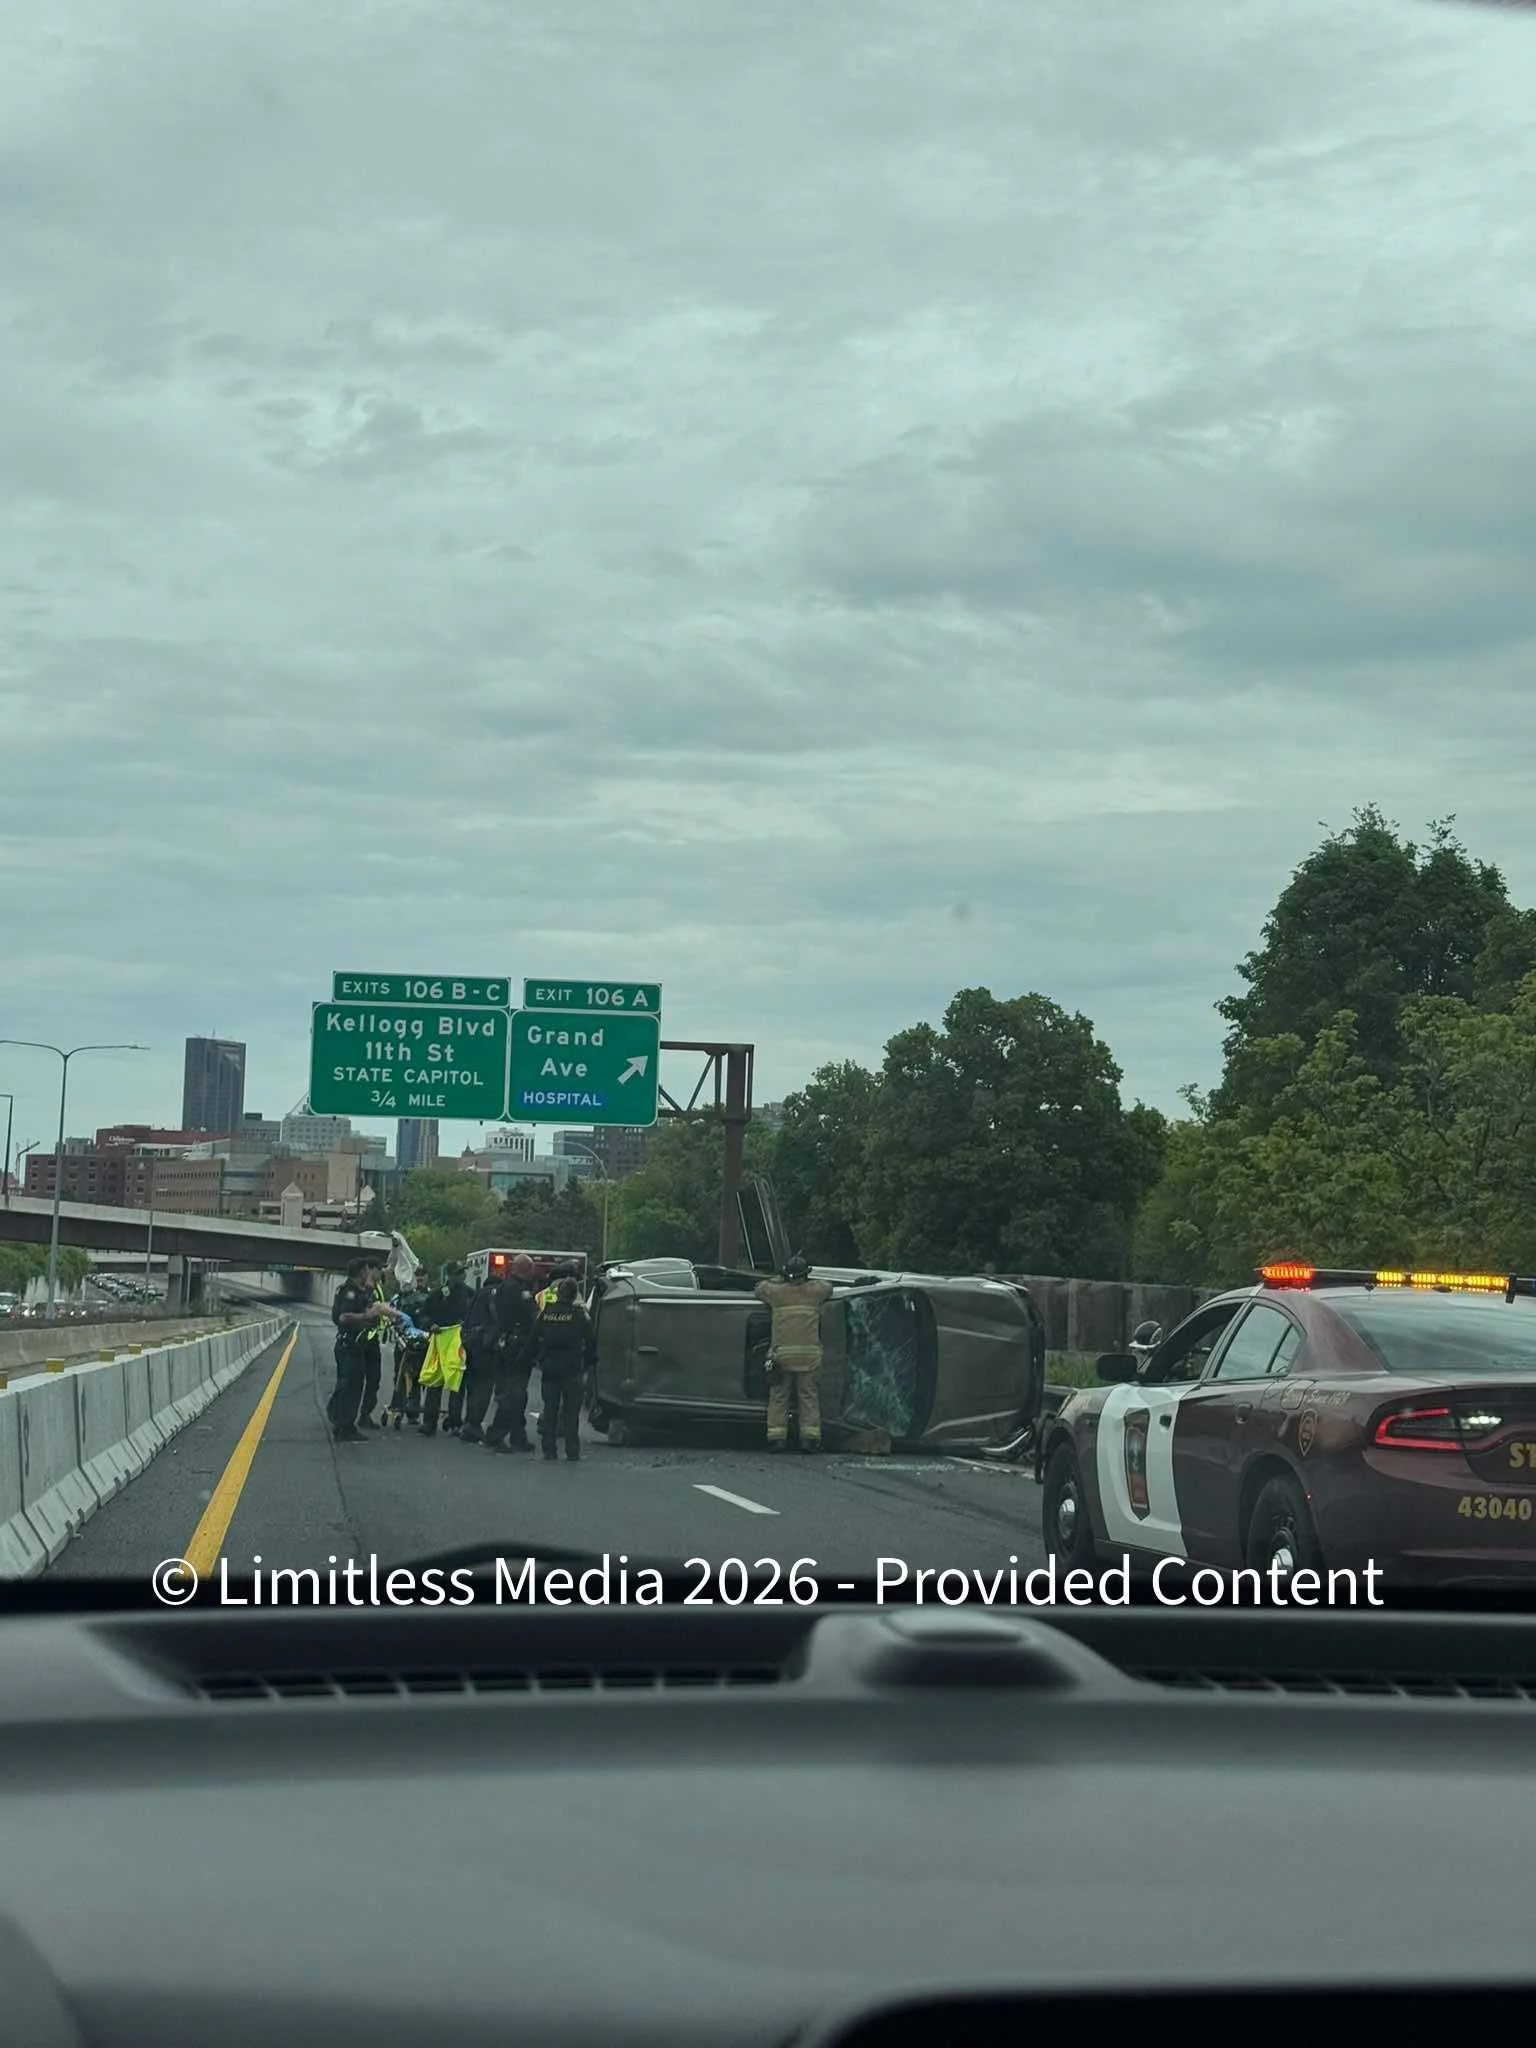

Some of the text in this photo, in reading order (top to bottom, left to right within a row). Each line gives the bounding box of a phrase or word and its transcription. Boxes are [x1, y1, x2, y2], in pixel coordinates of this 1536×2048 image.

[342, 980, 391, 994] EXITS
[404, 981, 444, 999] 106
[536, 988, 648, 1007] EXIT 106 A
[327, 1012, 495, 1038] Kellogg Blvd
[528, 1026, 604, 1047] Grand
[366, 1042, 454, 1063] 11th St
[333, 1067, 484, 1086] STATE CAPITOL
[541, 1058, 588, 1077] Ave
[409, 1094, 446, 1107] MILE
[523, 1091, 602, 1107] HOSPITAL
[1458, 1496, 1532, 1520] 43040
